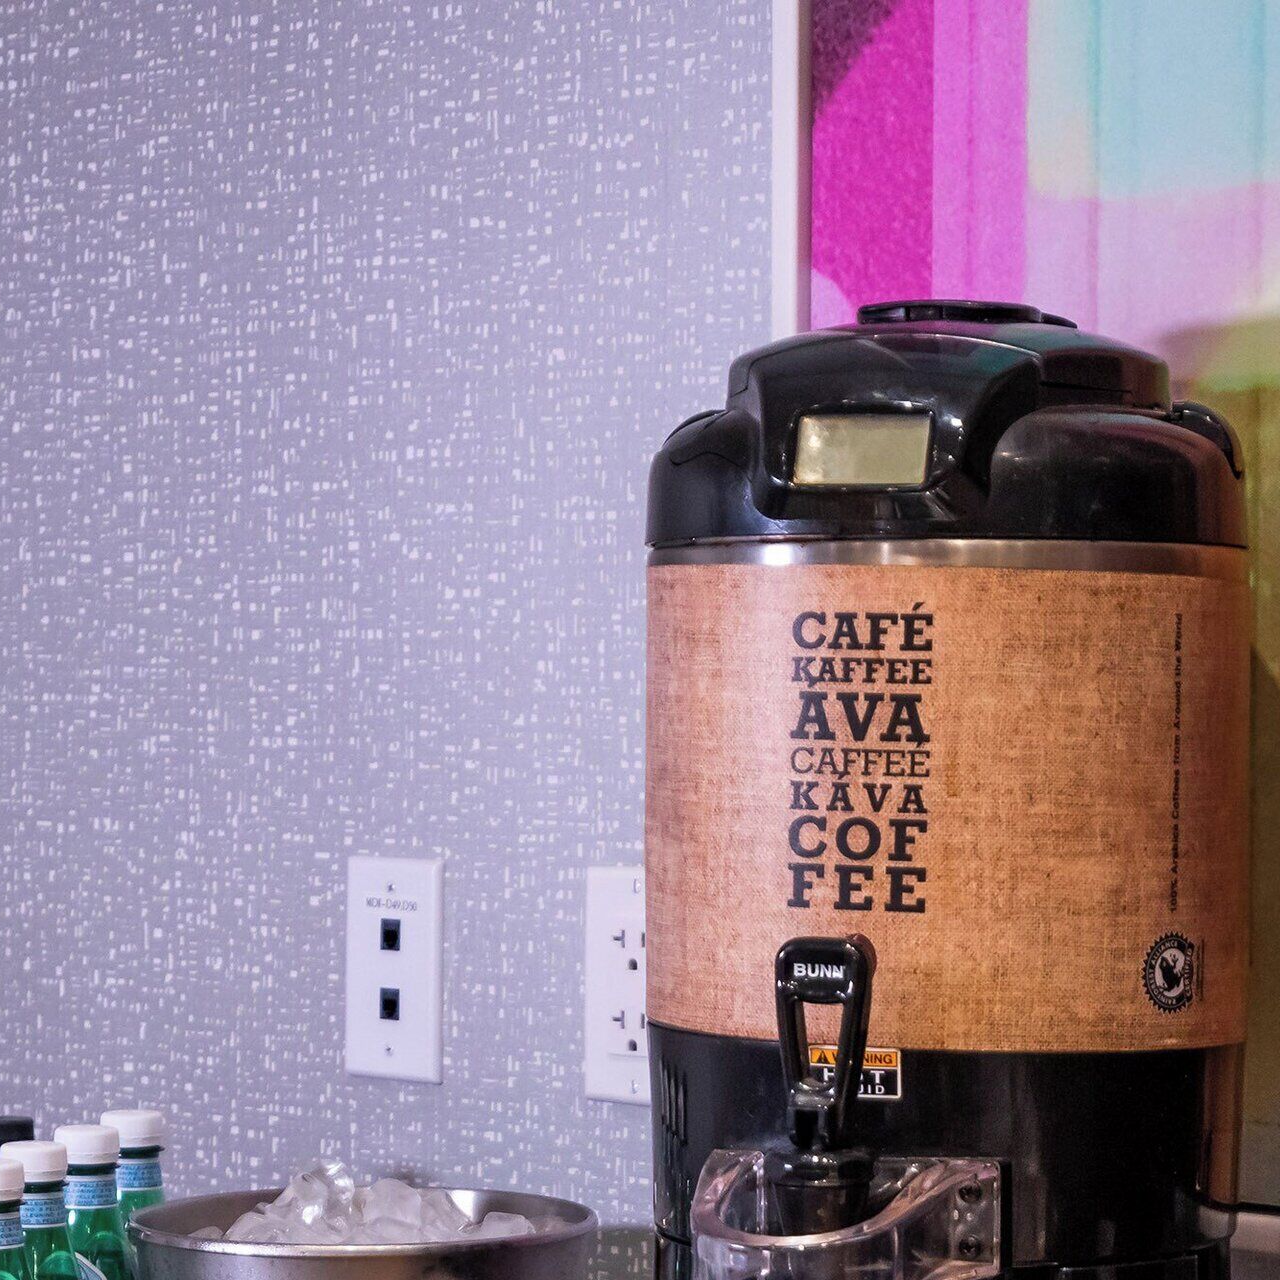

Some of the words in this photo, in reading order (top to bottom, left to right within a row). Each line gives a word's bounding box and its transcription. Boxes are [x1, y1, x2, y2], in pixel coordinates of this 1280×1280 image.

[792, 602, 933, 651] CAFÉ
[1174, 612, 1183, 652] World
[791, 656, 932, 685] KAFFEE
[1174, 656, 1183, 677] the
[1173, 681, 1183, 729] Around
[1173, 734, 1182, 764] from
[788, 815, 928, 861] COF
[787, 863, 927, 913] FEE
[793, 963, 845, 979] BUNN
[832, 1051, 893, 1064] NING
[823, 1067, 885, 1084] HT
